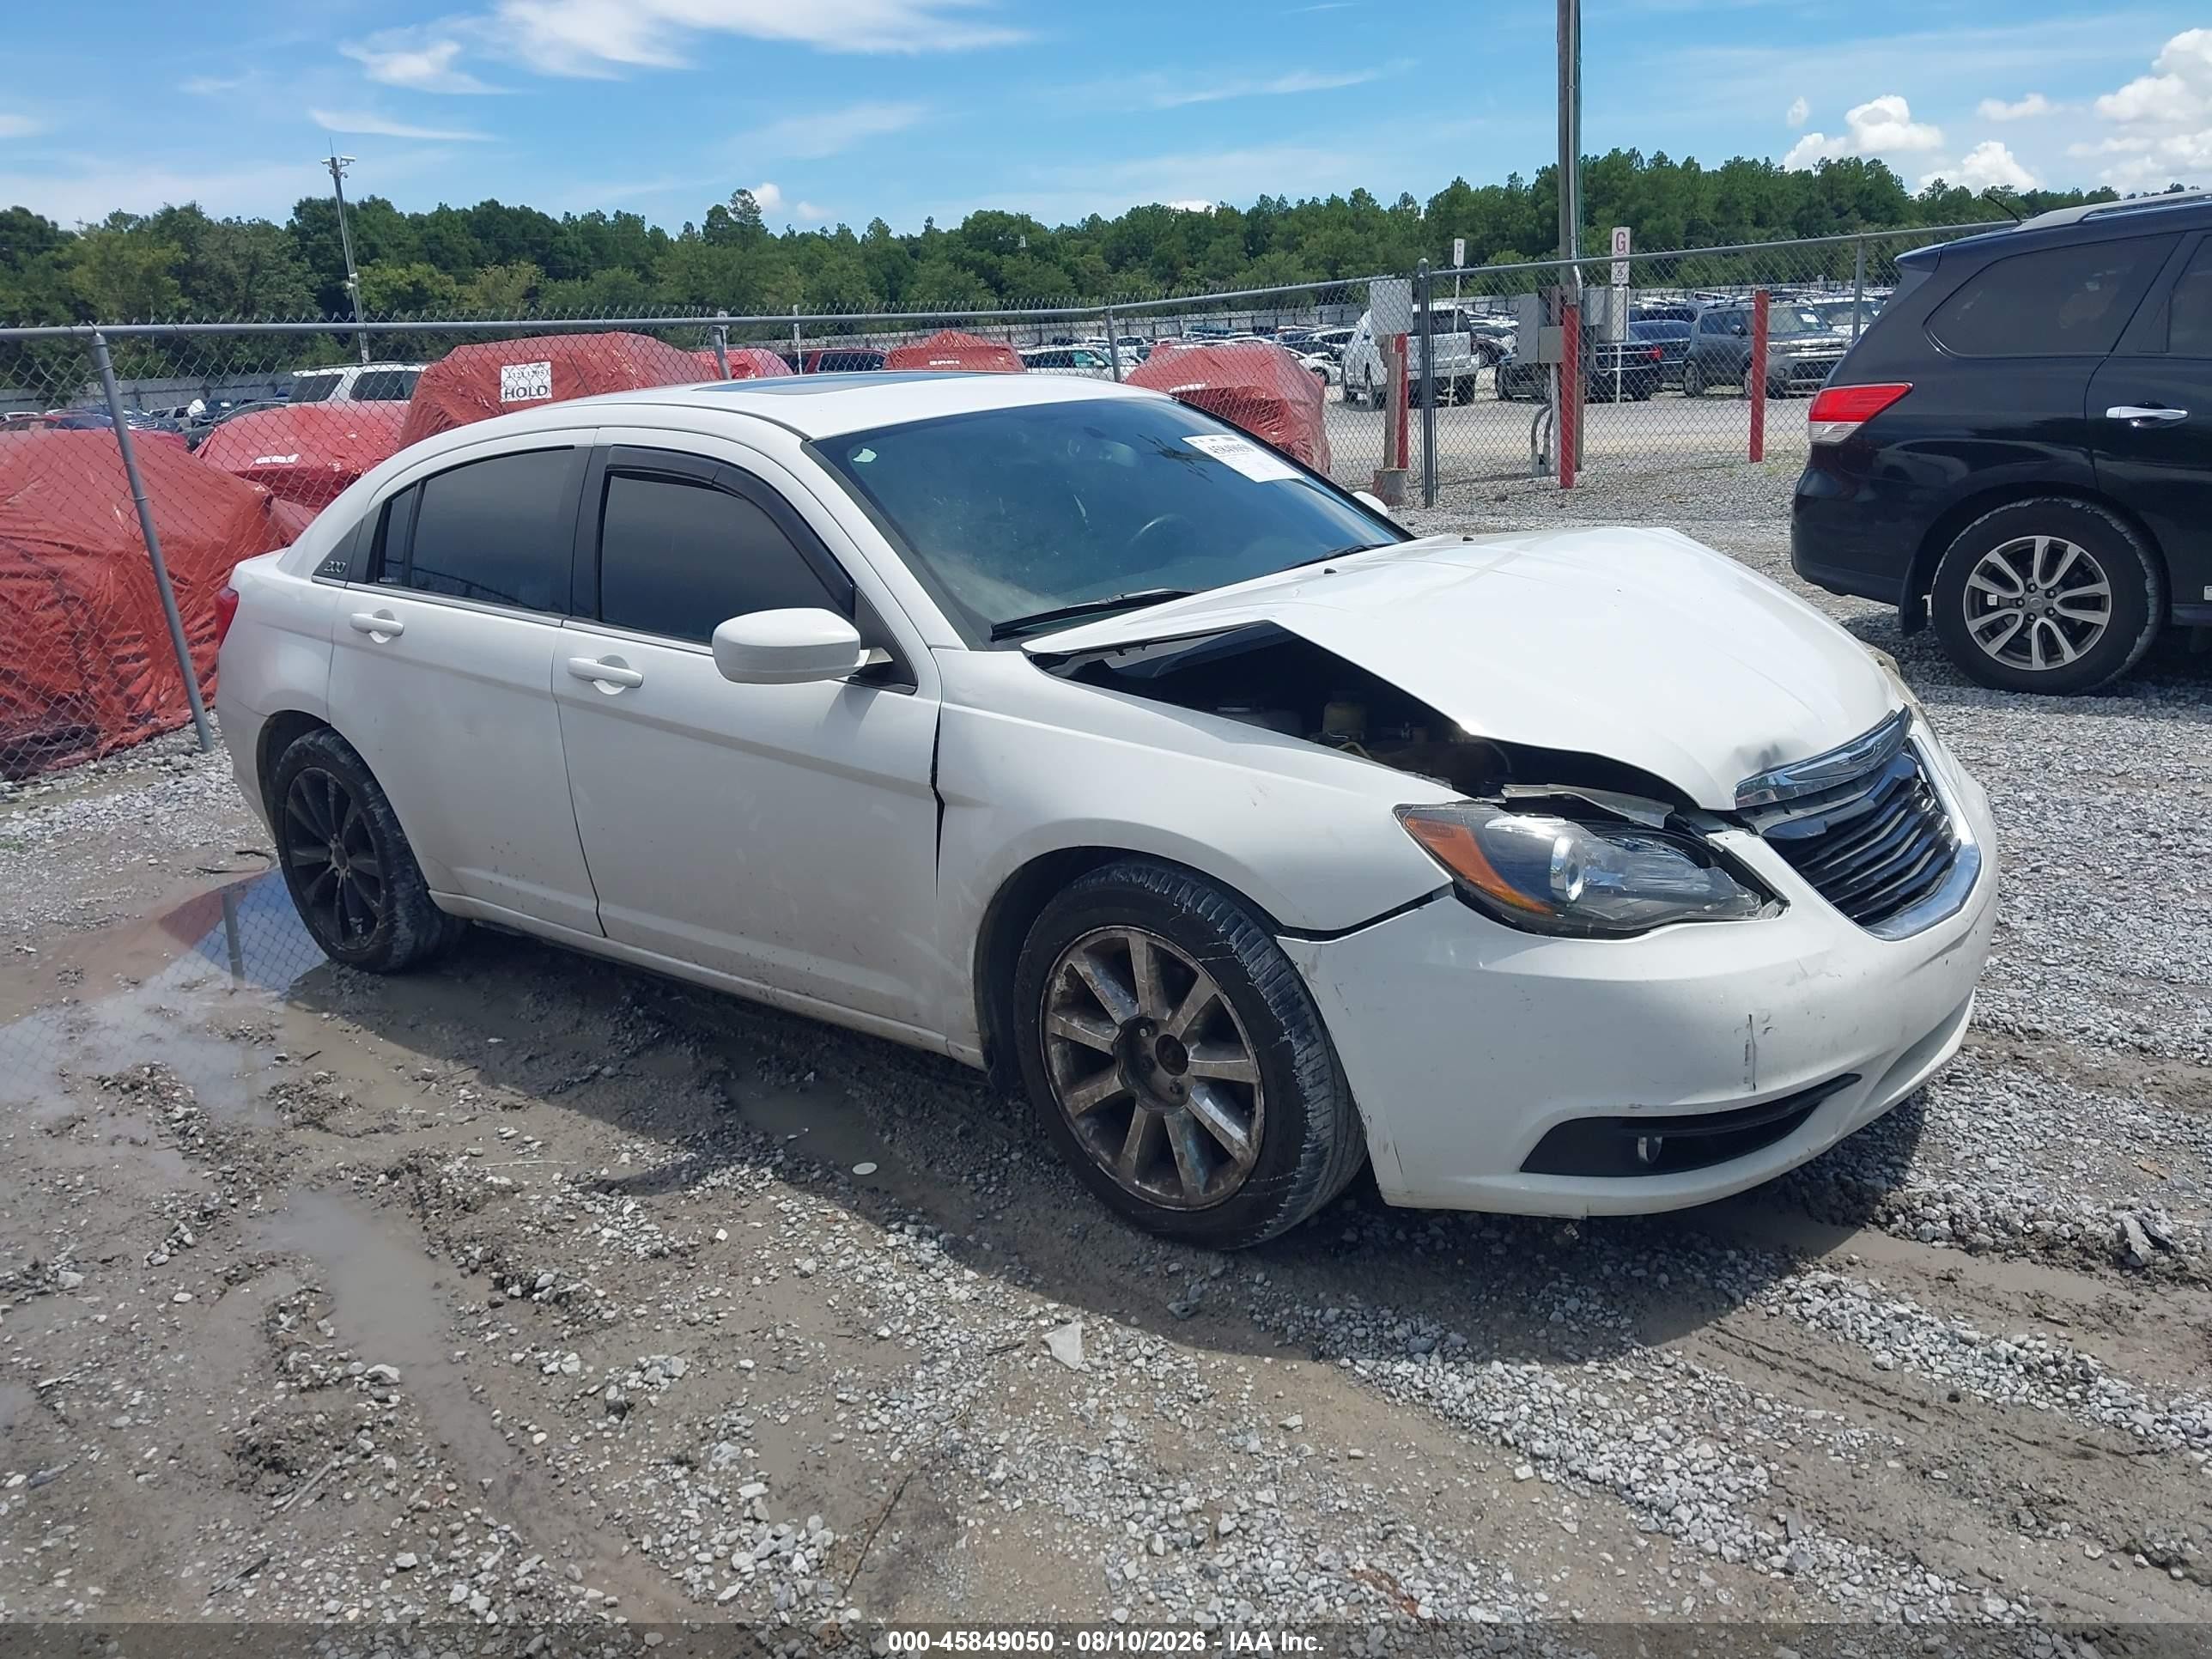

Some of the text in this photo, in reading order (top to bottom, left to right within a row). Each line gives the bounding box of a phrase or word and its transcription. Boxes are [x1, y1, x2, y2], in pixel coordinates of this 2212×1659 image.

[1615, 231, 1626, 252] G
[505, 386, 548, 399] HOLD
[323, 560, 347, 574] 200
